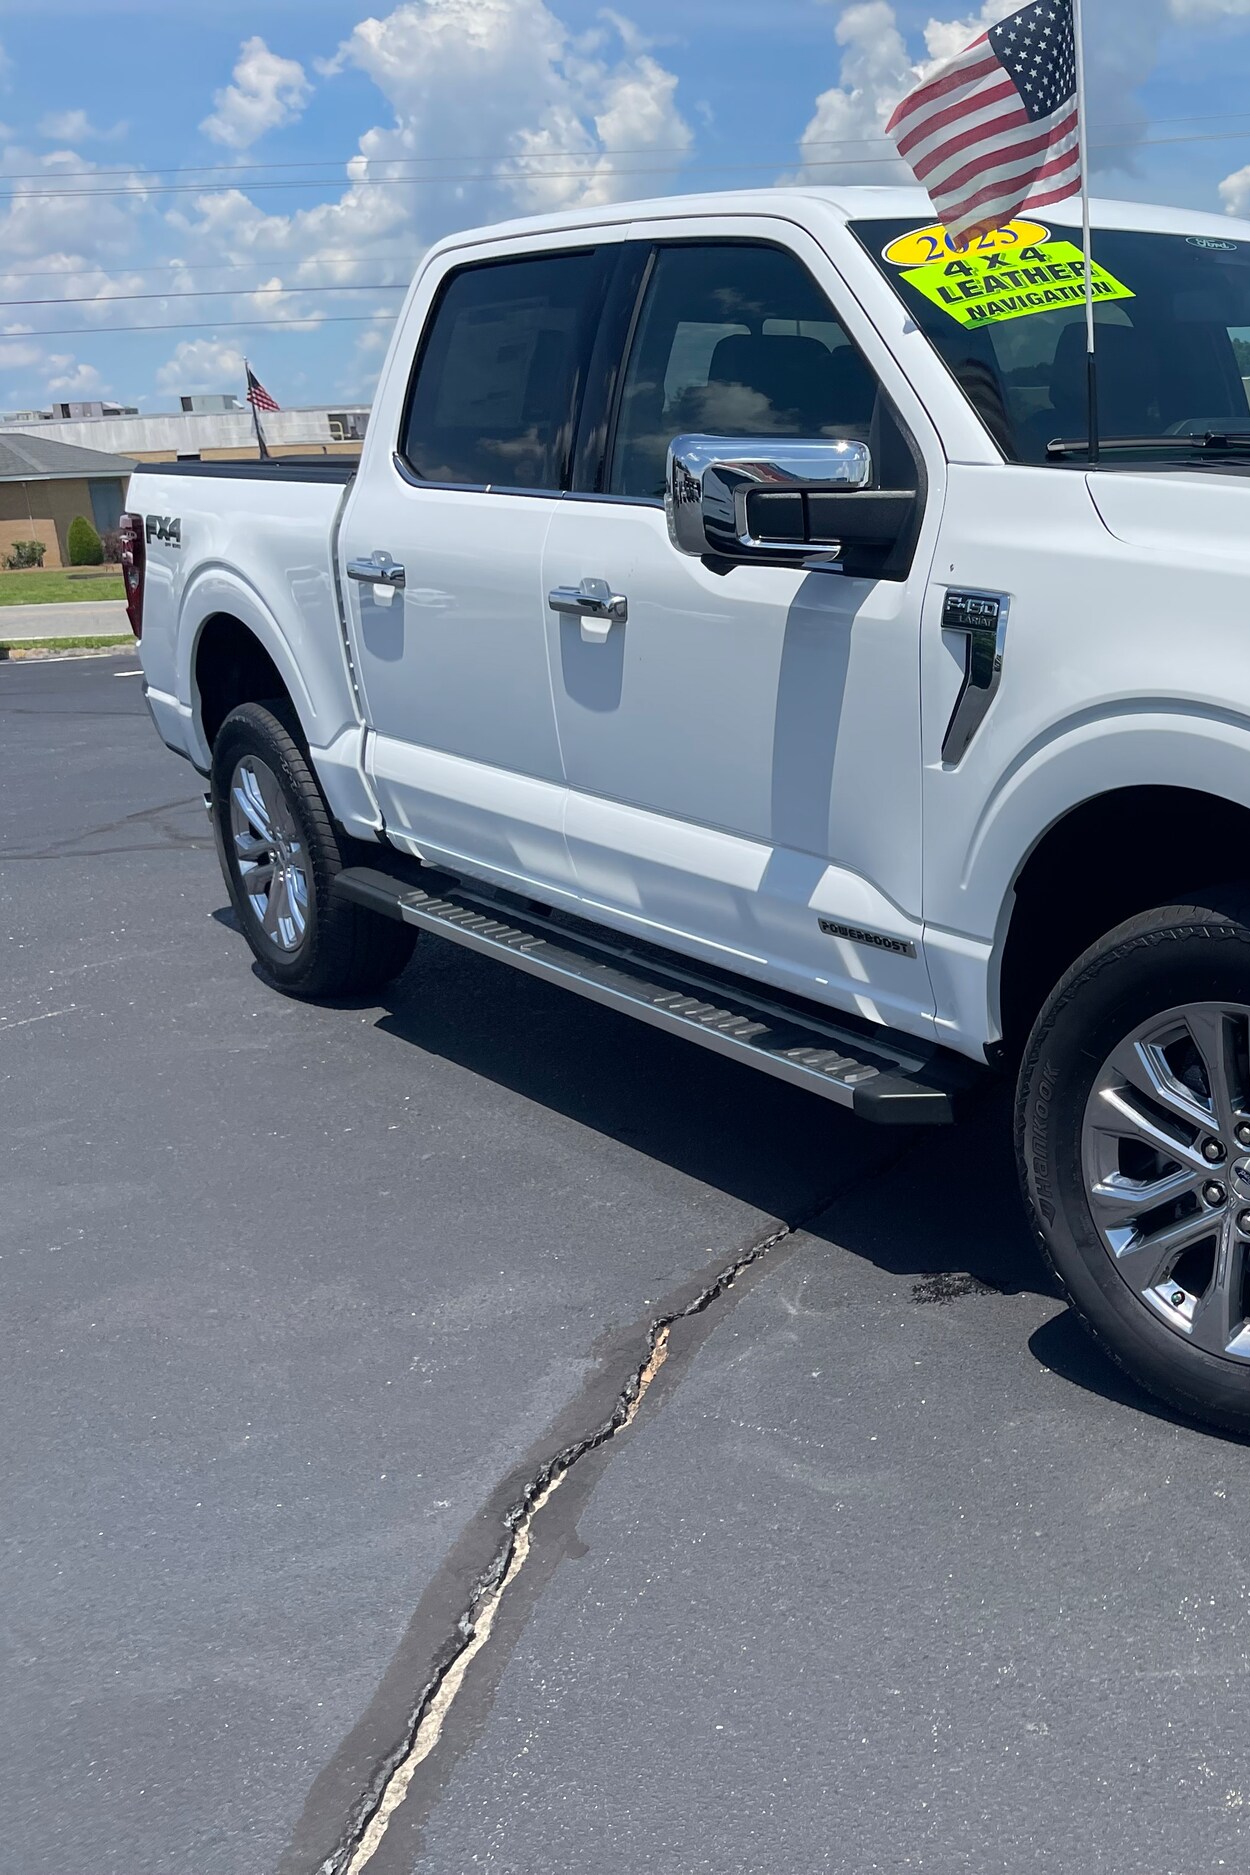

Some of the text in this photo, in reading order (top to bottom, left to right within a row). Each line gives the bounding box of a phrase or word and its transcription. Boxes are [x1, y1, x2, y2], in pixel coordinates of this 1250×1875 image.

[1195, 238, 1230, 249] Ford
[943, 259, 974, 277] 4
[1019, 246, 1048, 263] 4
[935, 260, 1095, 304] LEATHER
[965, 281, 1114, 321] NAVIGATION
[145, 514, 181, 544] FX4
[820, 920, 909, 954] POWERBOOST
